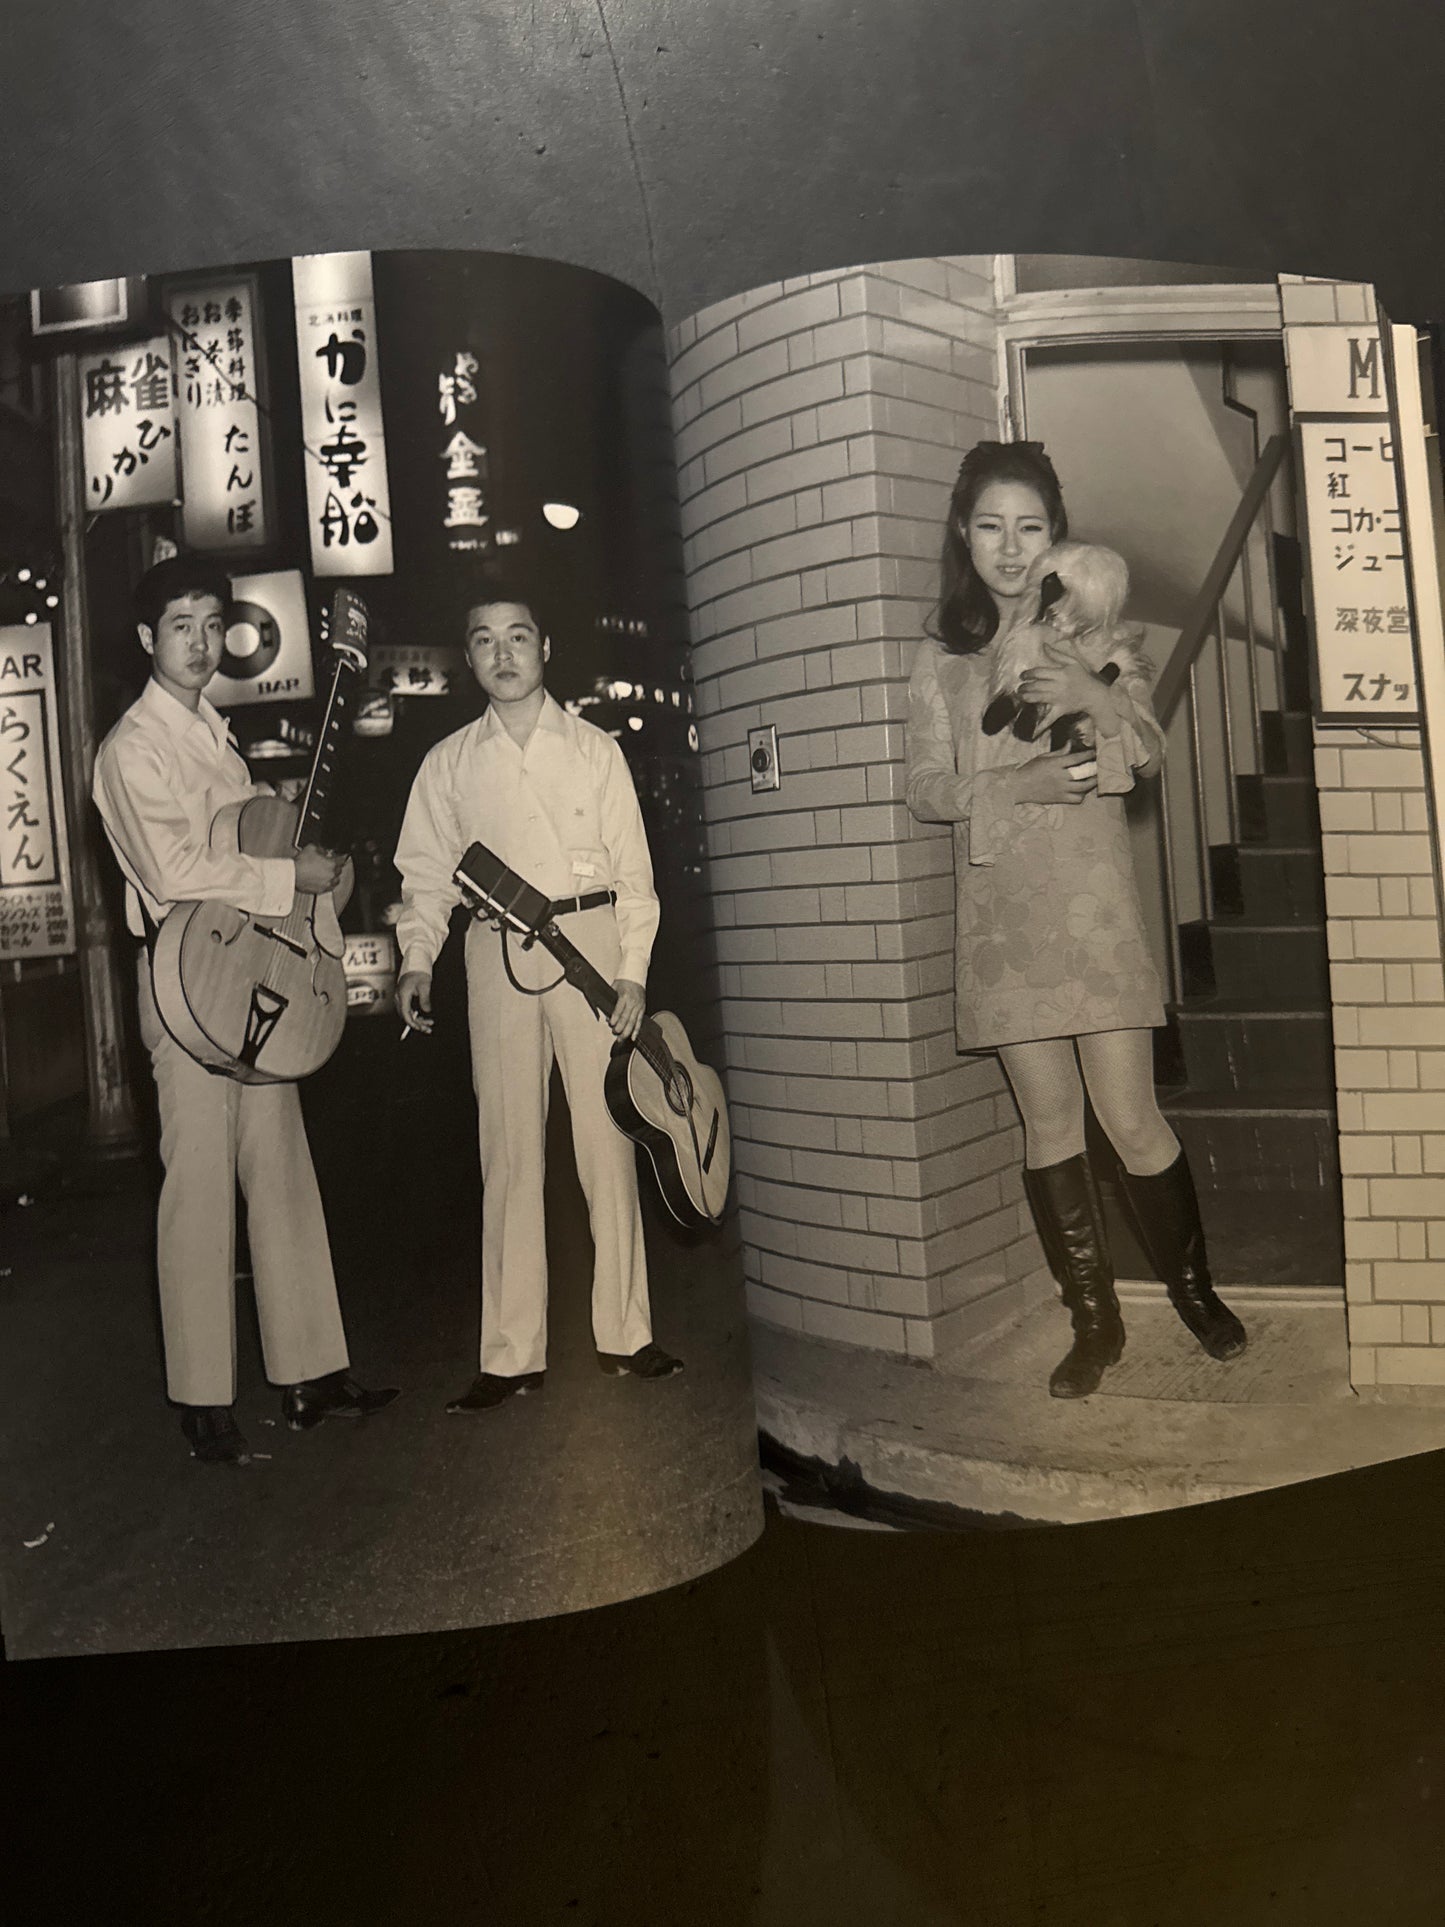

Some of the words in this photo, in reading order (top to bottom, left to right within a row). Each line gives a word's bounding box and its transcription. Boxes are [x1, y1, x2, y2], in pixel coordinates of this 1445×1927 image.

[85, 352, 171, 418] 麻雀
[1347, 338, 1381, 400] M
[1327, 472, 1352, 499] 紅
[0, 653, 44, 681] AR
[257, 678, 300, 696] BAR
[0, 707, 45, 873] らくえん
